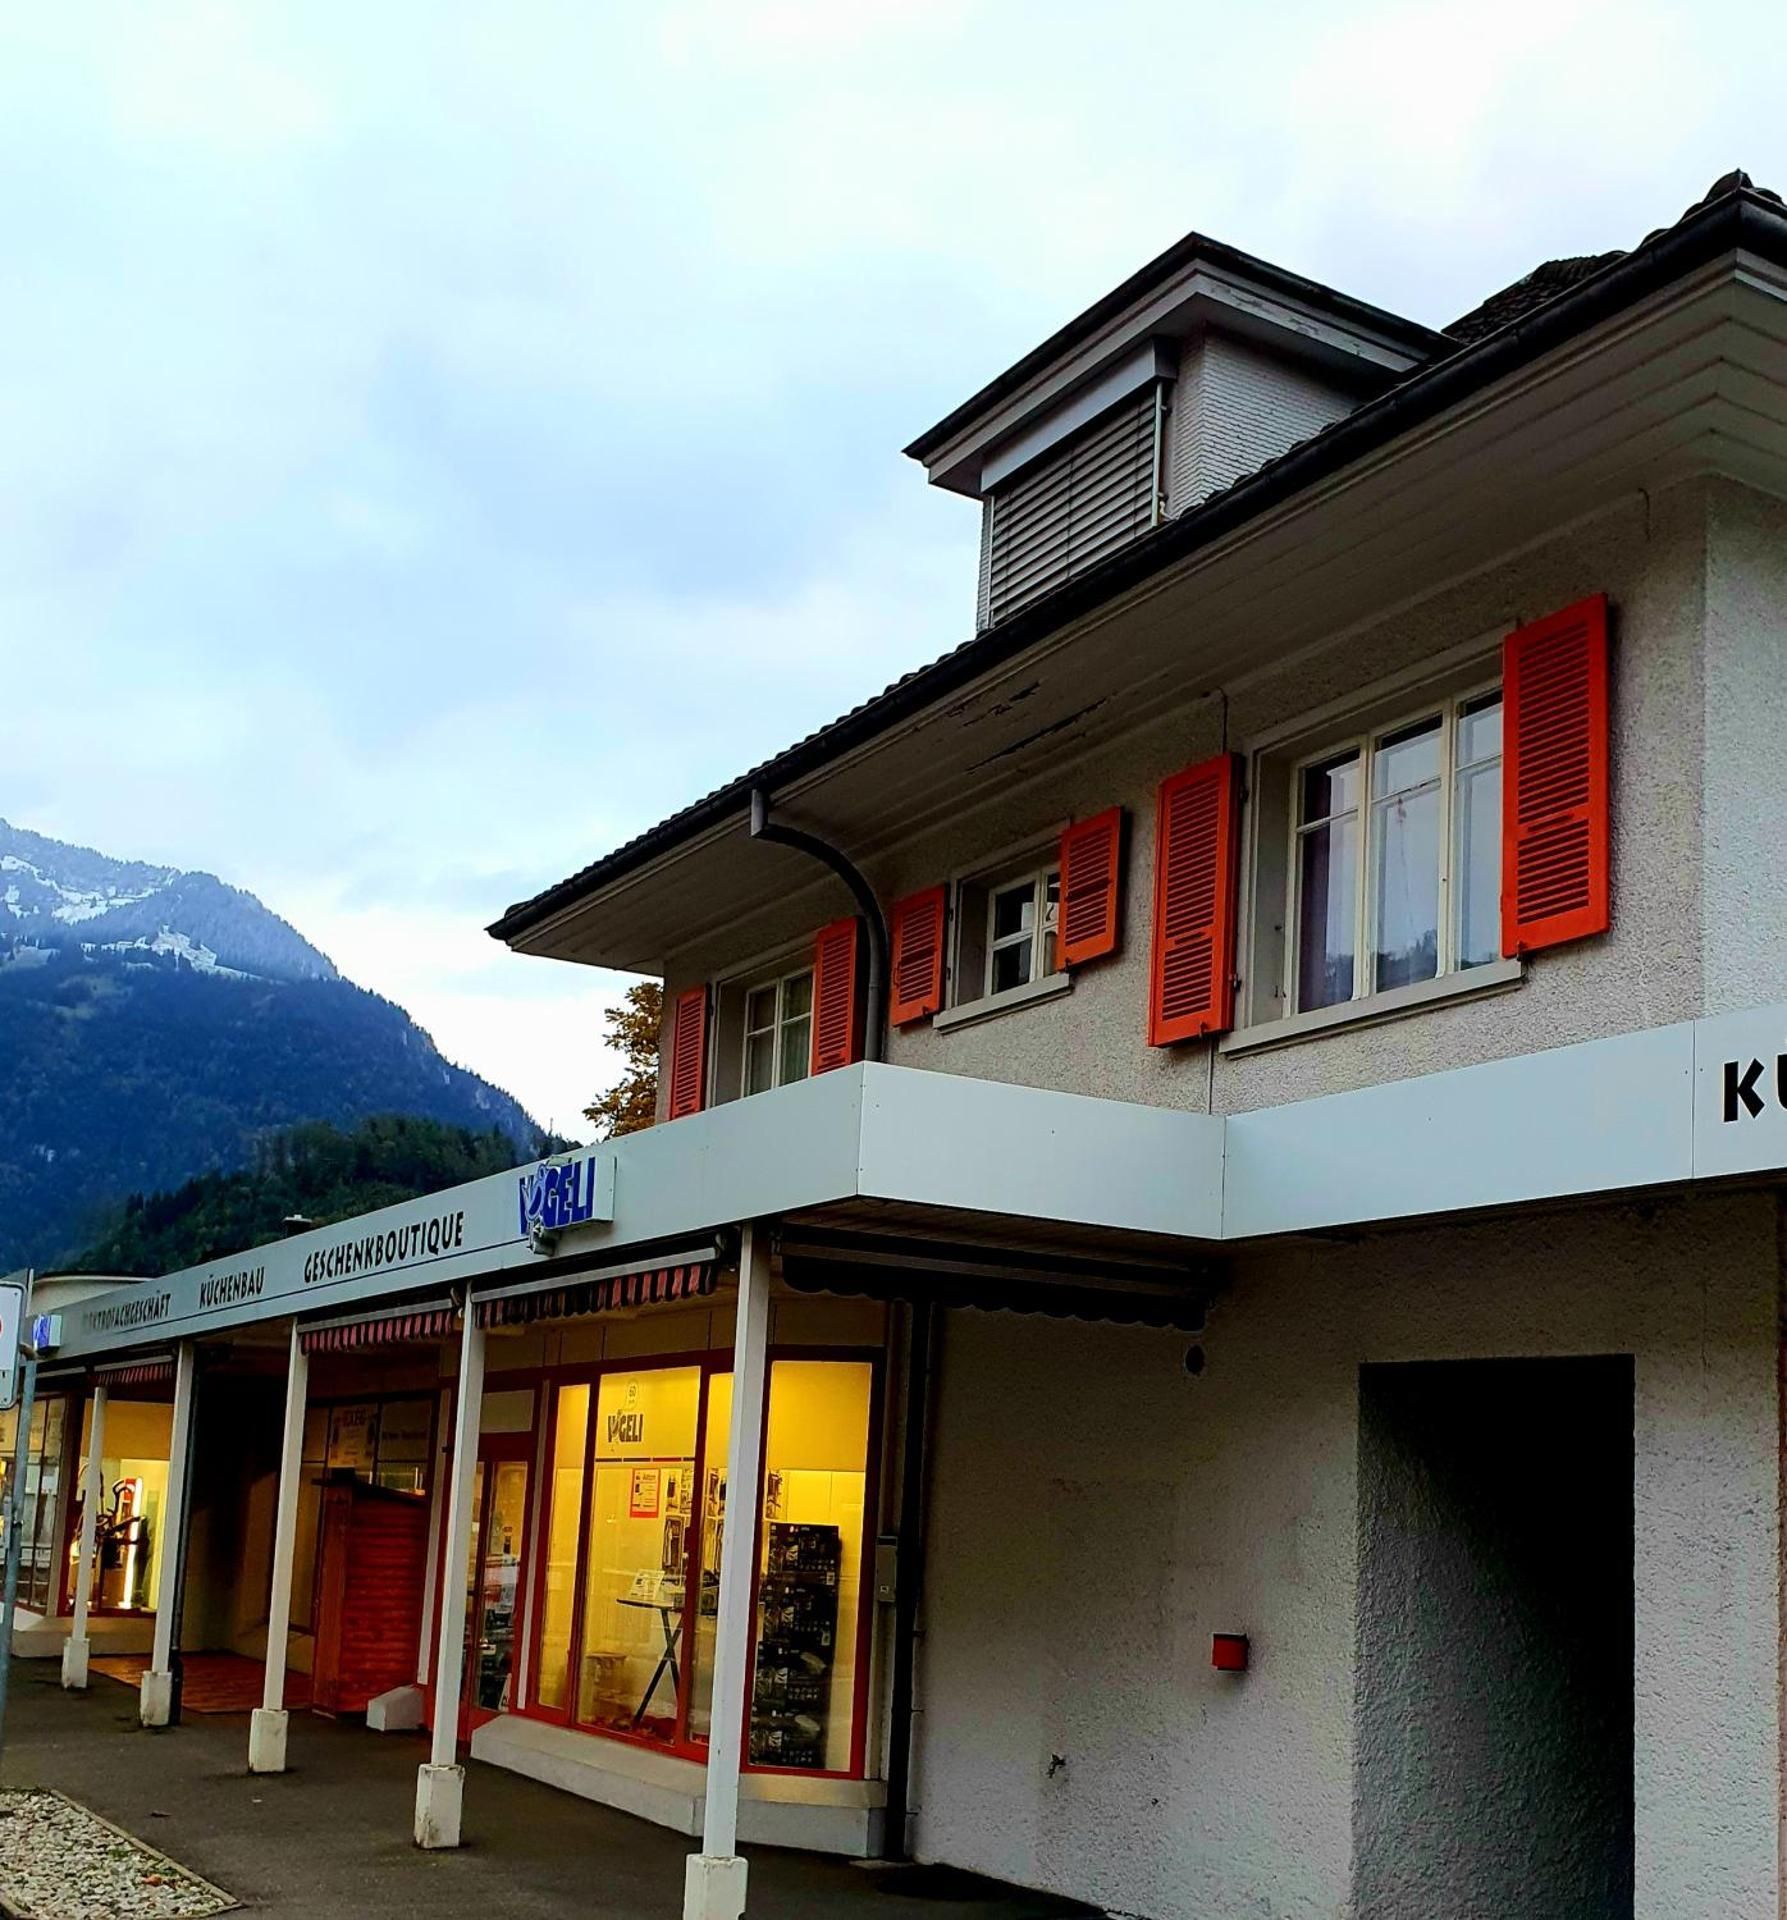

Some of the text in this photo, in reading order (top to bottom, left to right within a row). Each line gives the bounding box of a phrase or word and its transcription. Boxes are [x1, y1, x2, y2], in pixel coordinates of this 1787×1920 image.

[1723, 1055, 1787, 1122] K
[200, 1266, 264, 1309] KÜCHENBAU
[304, 1211, 464, 1283] GESCHENKBOUTIQUE
